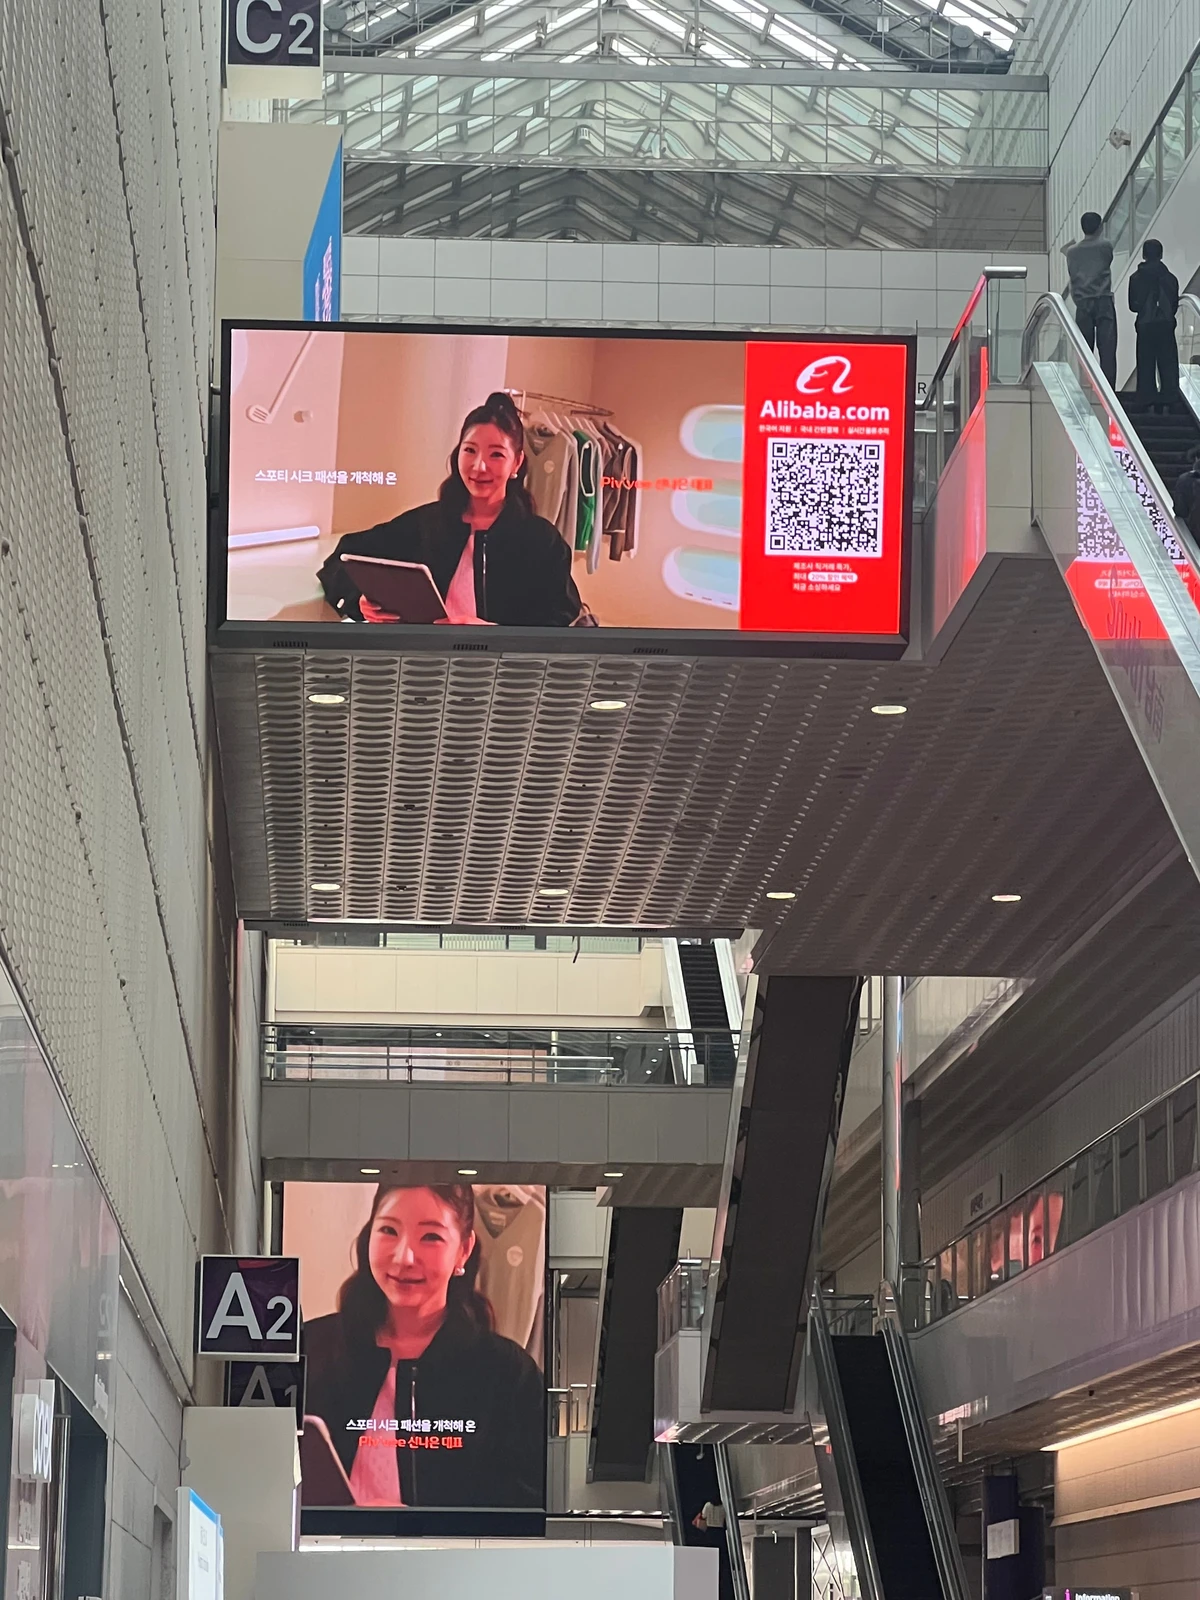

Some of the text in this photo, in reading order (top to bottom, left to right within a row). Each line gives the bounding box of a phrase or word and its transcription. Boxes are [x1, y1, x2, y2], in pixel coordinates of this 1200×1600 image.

[236, 0, 314, 54] C2
[760, 400, 890, 421] Alibaba.com
[255, 469, 397, 485] 스포티 시크 패션을 개척해 온
[206, 1272, 293, 1340] A2
[238, 1365, 297, 1407] A1
[346, 1418, 476, 1433] 스포티 시크 패션을 개척해 온
[407, 1436, 440, 1449] 신나은
[441, 1436, 463, 1449] 대표
